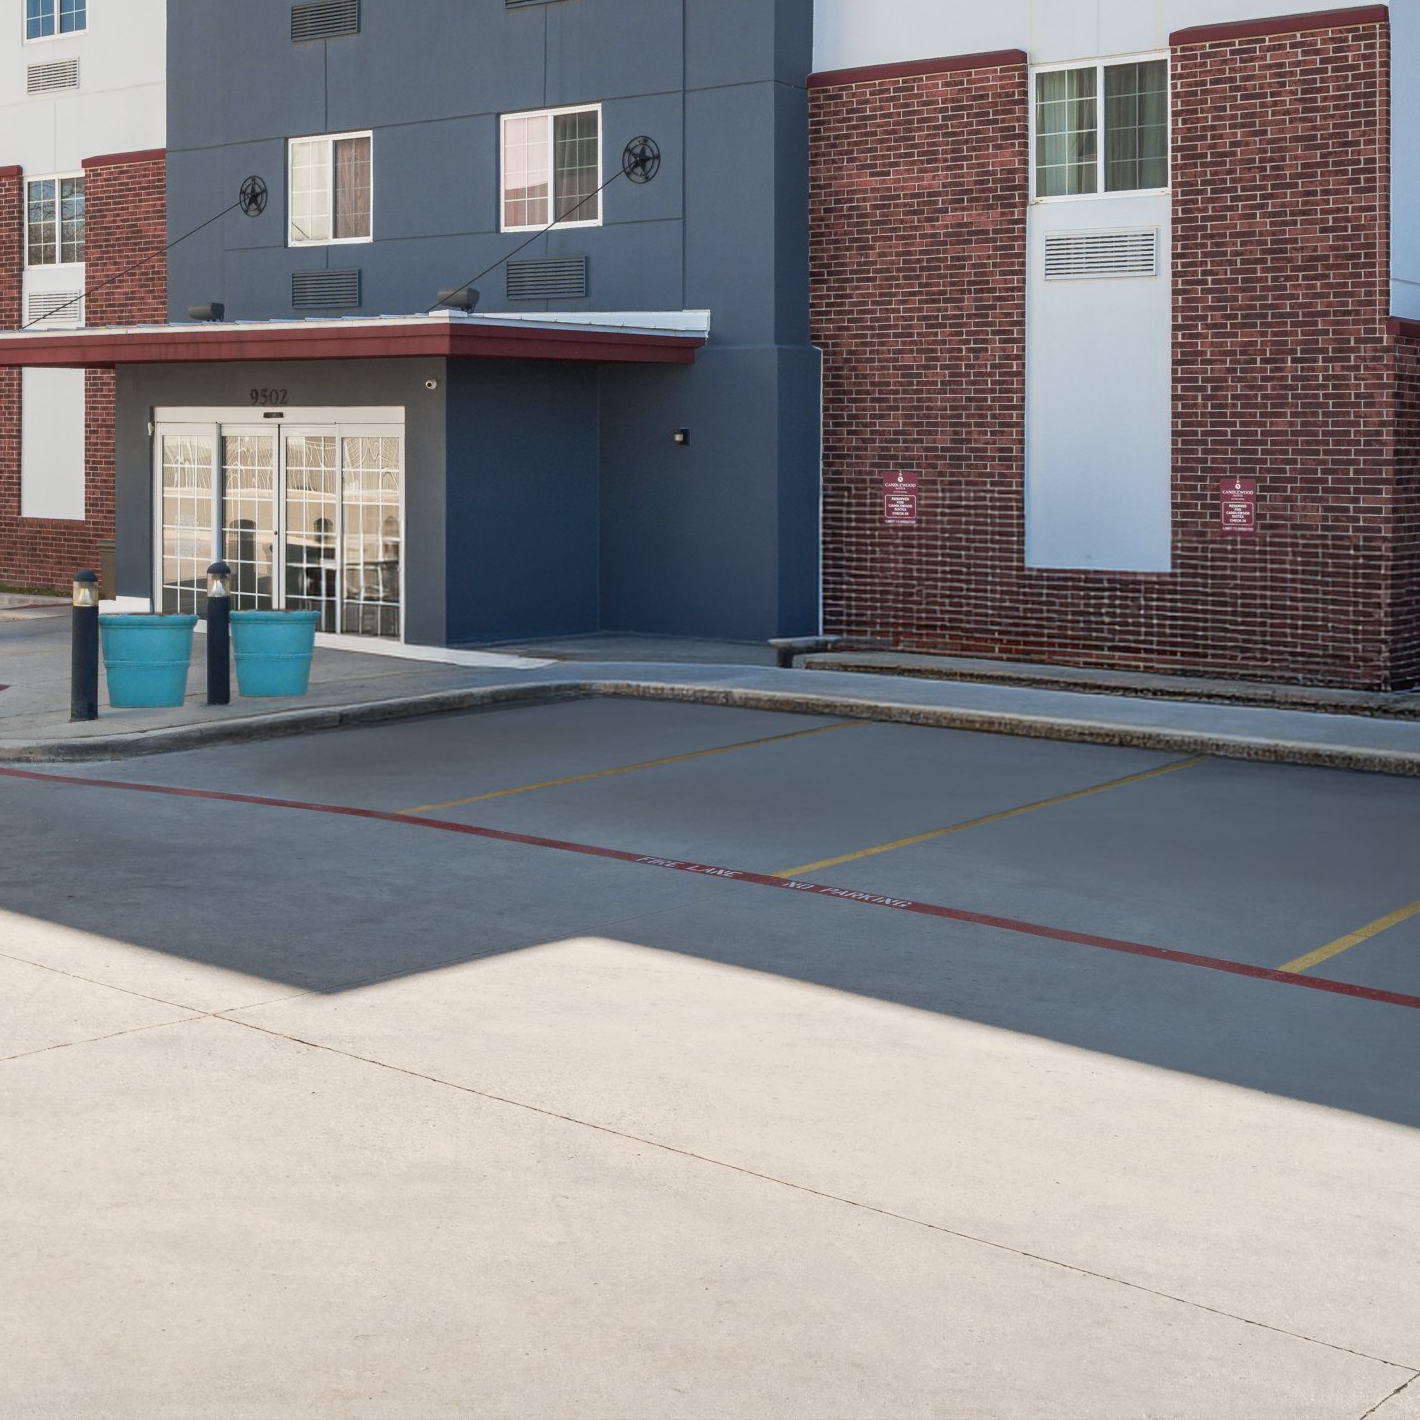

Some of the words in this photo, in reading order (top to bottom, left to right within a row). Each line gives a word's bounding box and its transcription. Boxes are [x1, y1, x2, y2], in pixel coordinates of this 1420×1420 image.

[250, 388, 288, 405] 9502
[636, 856, 685, 868] FIRE
[686, 865, 743, 878] LANE
[782, 881, 815, 890] NO
[820, 887, 912, 908] PARKING
